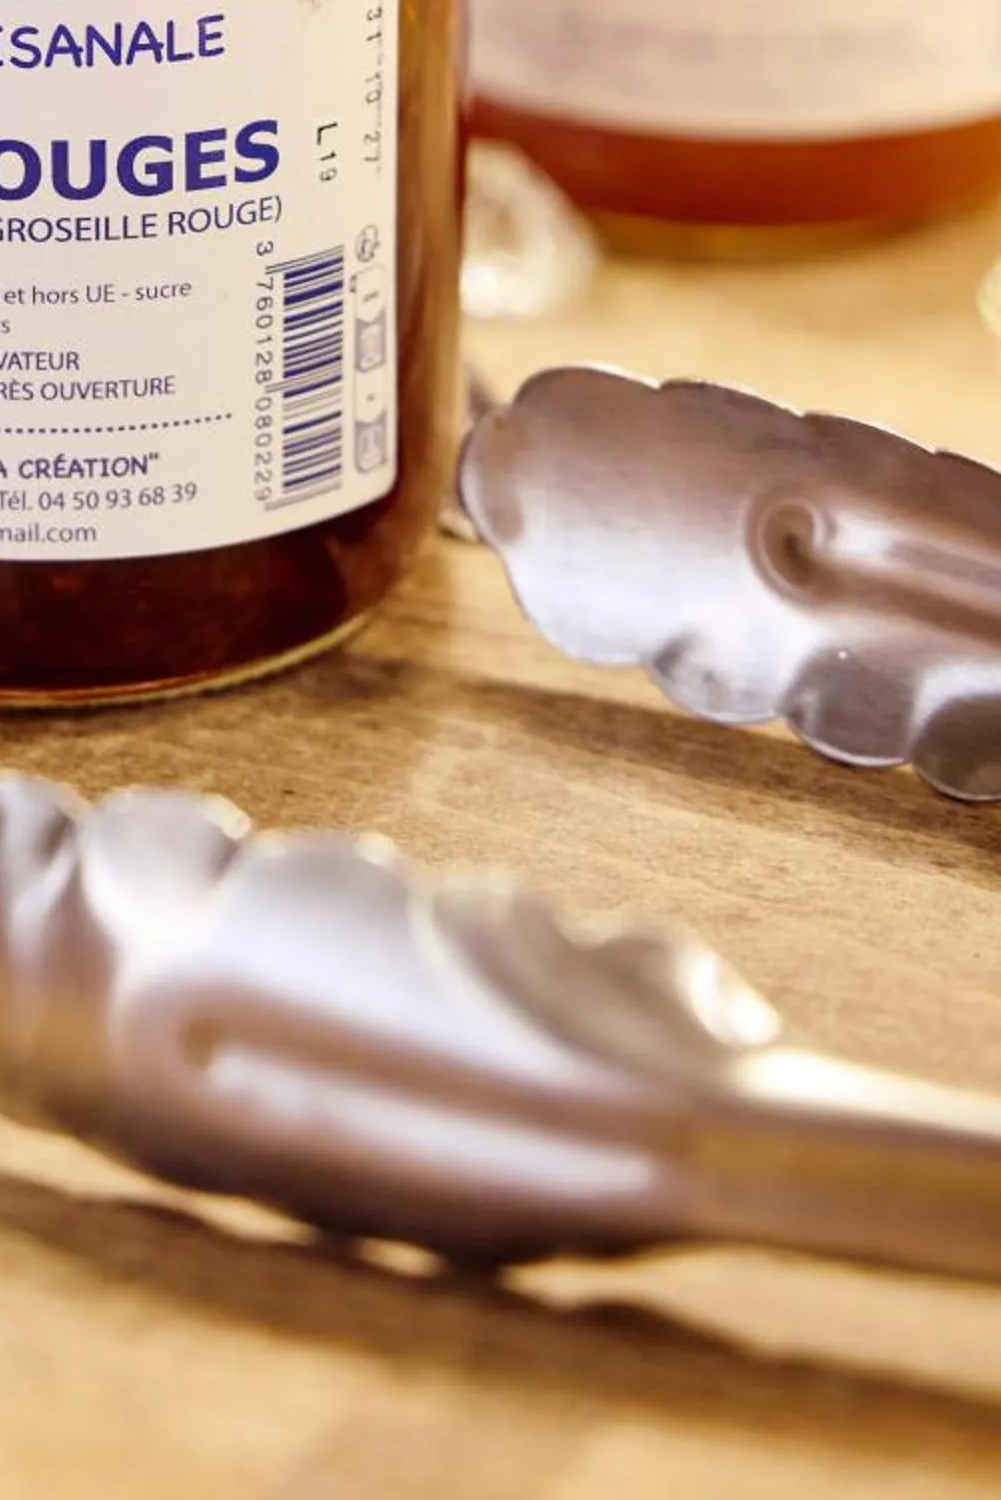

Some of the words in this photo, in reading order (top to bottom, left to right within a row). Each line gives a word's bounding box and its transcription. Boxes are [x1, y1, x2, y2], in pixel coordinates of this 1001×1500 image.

[168, 195, 282, 236] ROUGE)
[255, 240, 274, 257] 3
[4, 287, 25, 304] et
[32, 284, 79, 305] hors
[86, 284, 115, 303] UE
[135, 281, 193, 300] sucre
[255, 276, 275, 385] 760128
[40, 375, 176, 401] OUVERTURE
[19, 452, 160, 480] CRÉATION"
[39, 491, 65, 511] 04
[73, 490, 100, 511] 50
[106, 488, 132, 509] 93
[139, 485, 165, 506] 68
[172, 482, 198, 503] 39
